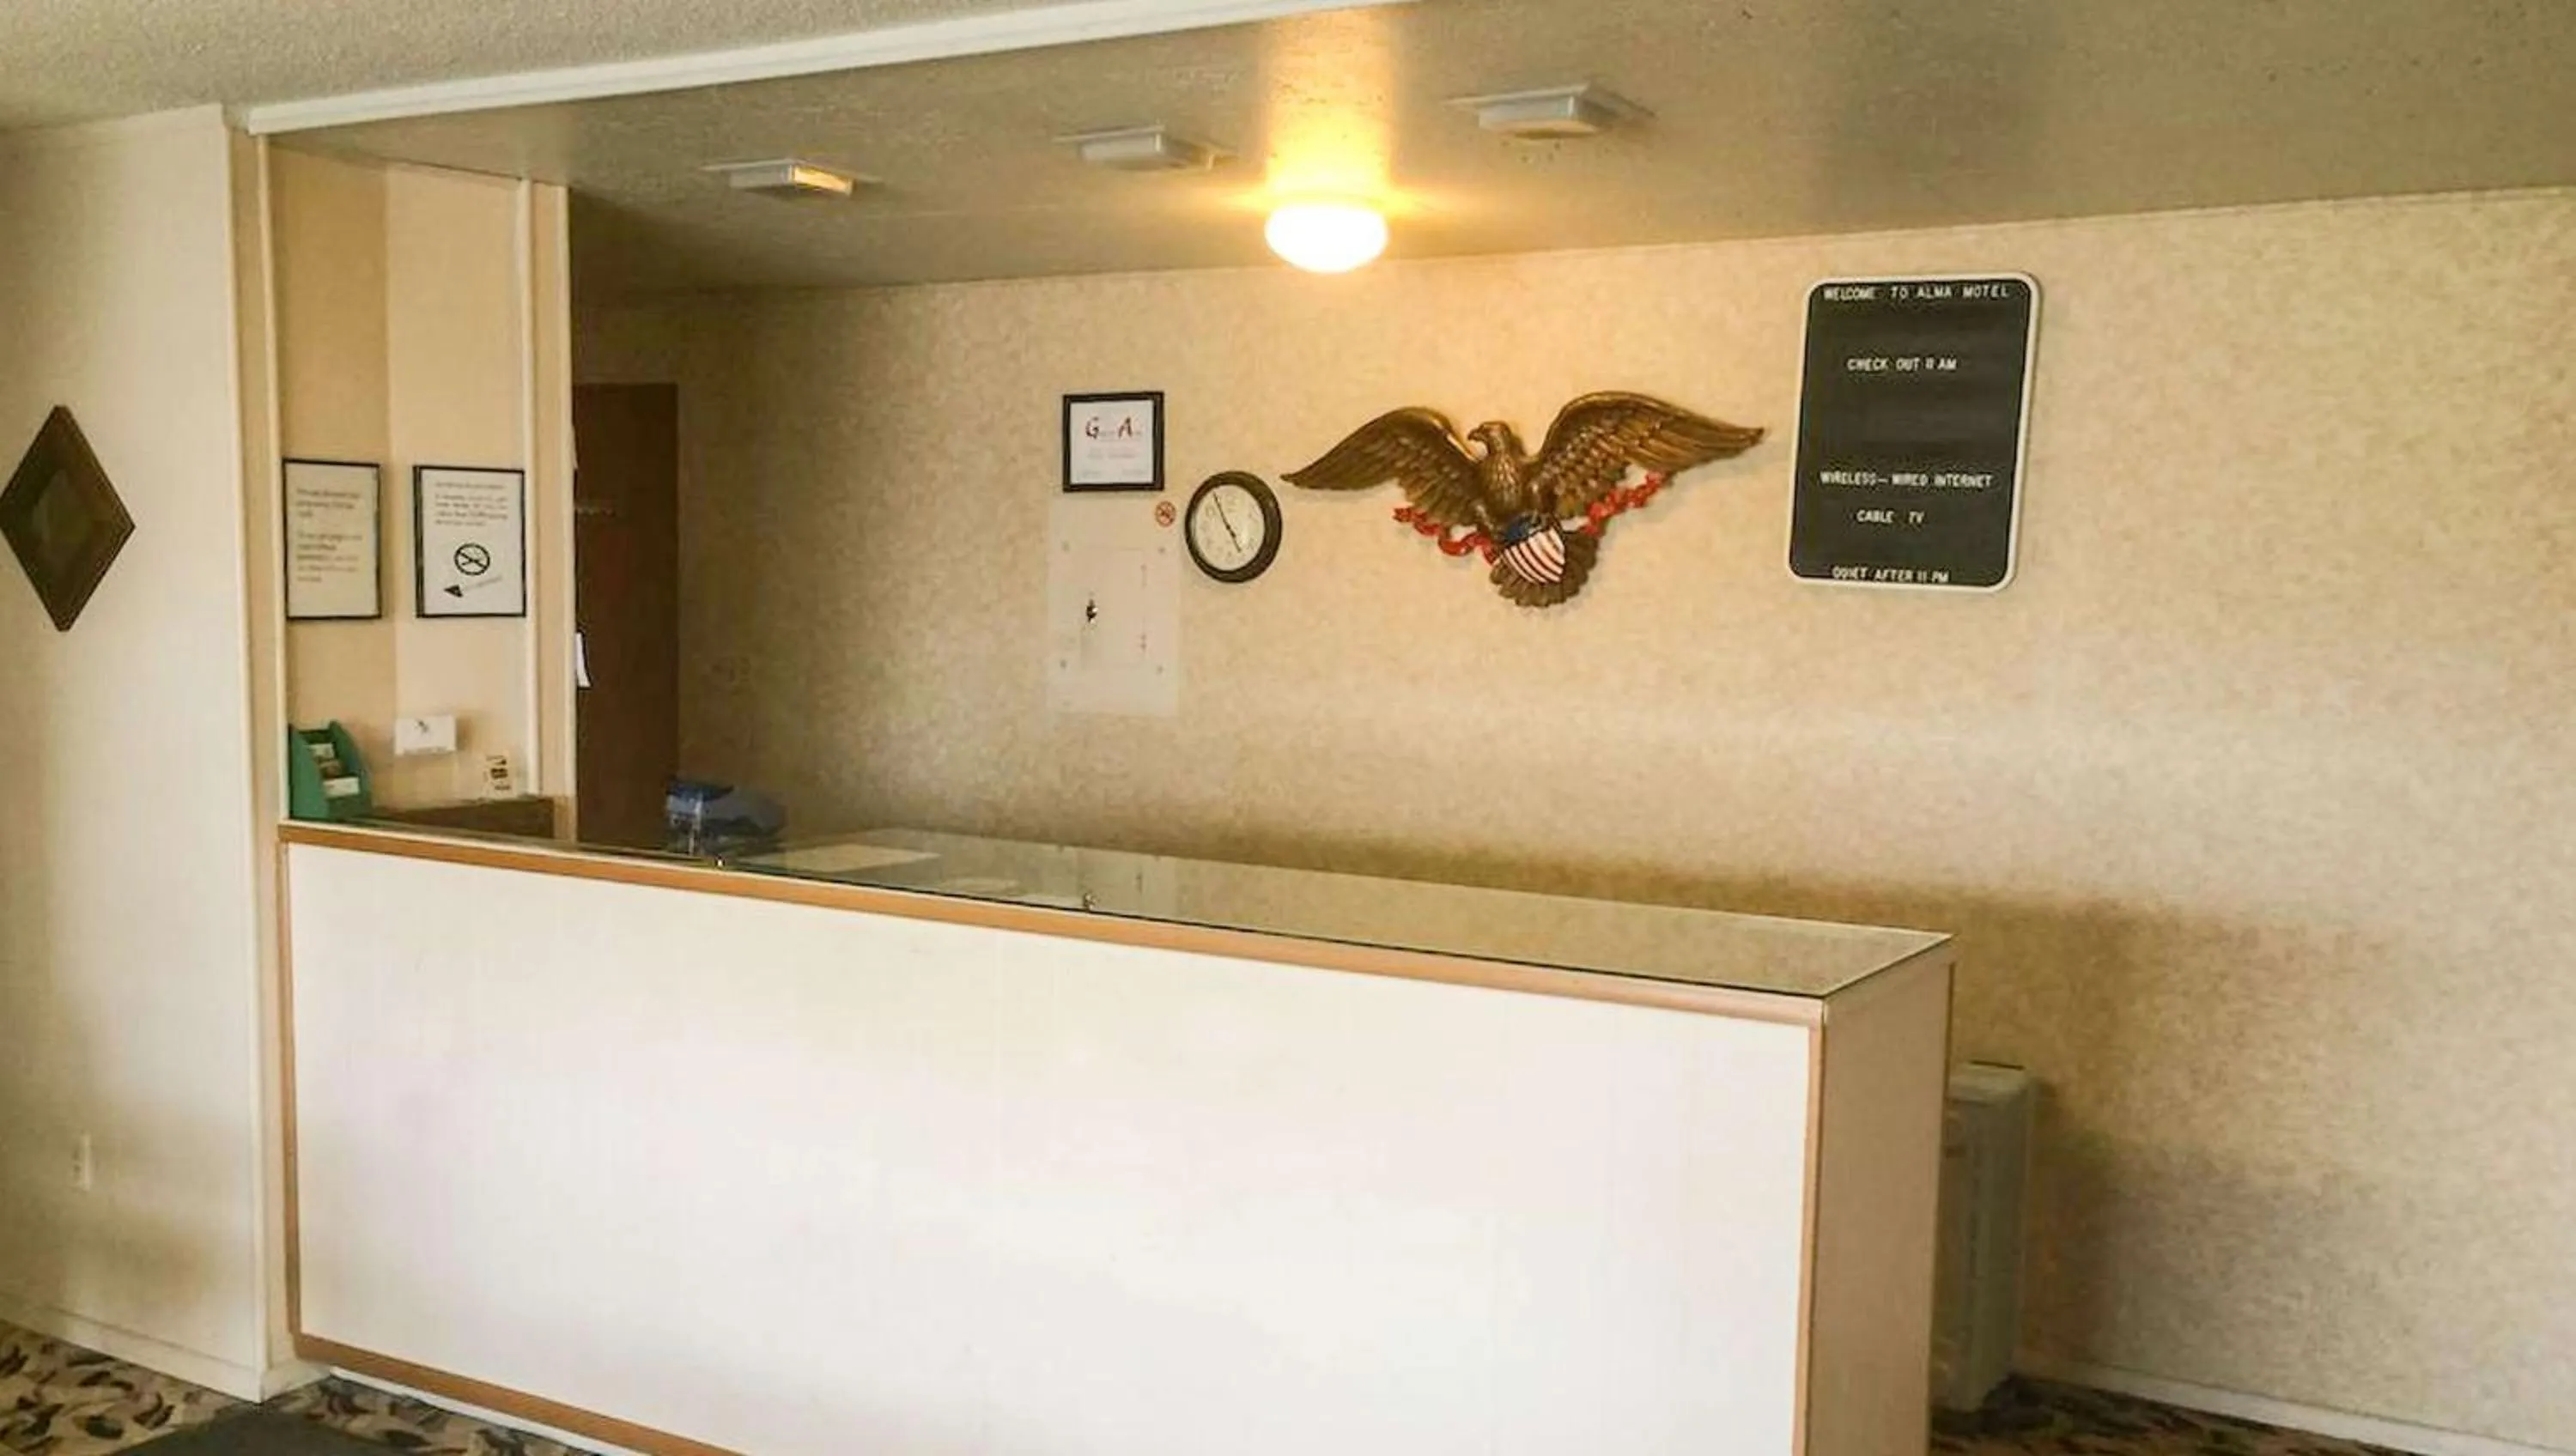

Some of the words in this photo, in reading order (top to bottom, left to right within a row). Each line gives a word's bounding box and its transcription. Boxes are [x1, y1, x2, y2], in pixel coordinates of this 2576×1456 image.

[1823, 286, 1876, 300] WELCOME
[1890, 286, 1909, 299] TO
[1917, 285, 1953, 299] ALMA
[1962, 285, 2009, 298] MOTEL
[1846, 357, 1889, 371] CHECK
[1895, 357, 1920, 371] OUT
[1937, 357, 1958, 370] AM
[1892, 473, 1929, 487] WIRED
[1934, 473, 1994, 488] INTERNET
[1856, 509, 1895, 524] CABLE
[1908, 511, 1925, 524] TV
[1832, 566, 1868, 579] QUIET
[1874, 568, 1913, 582] AFTER
[1932, 570, 1950, 583] PM
